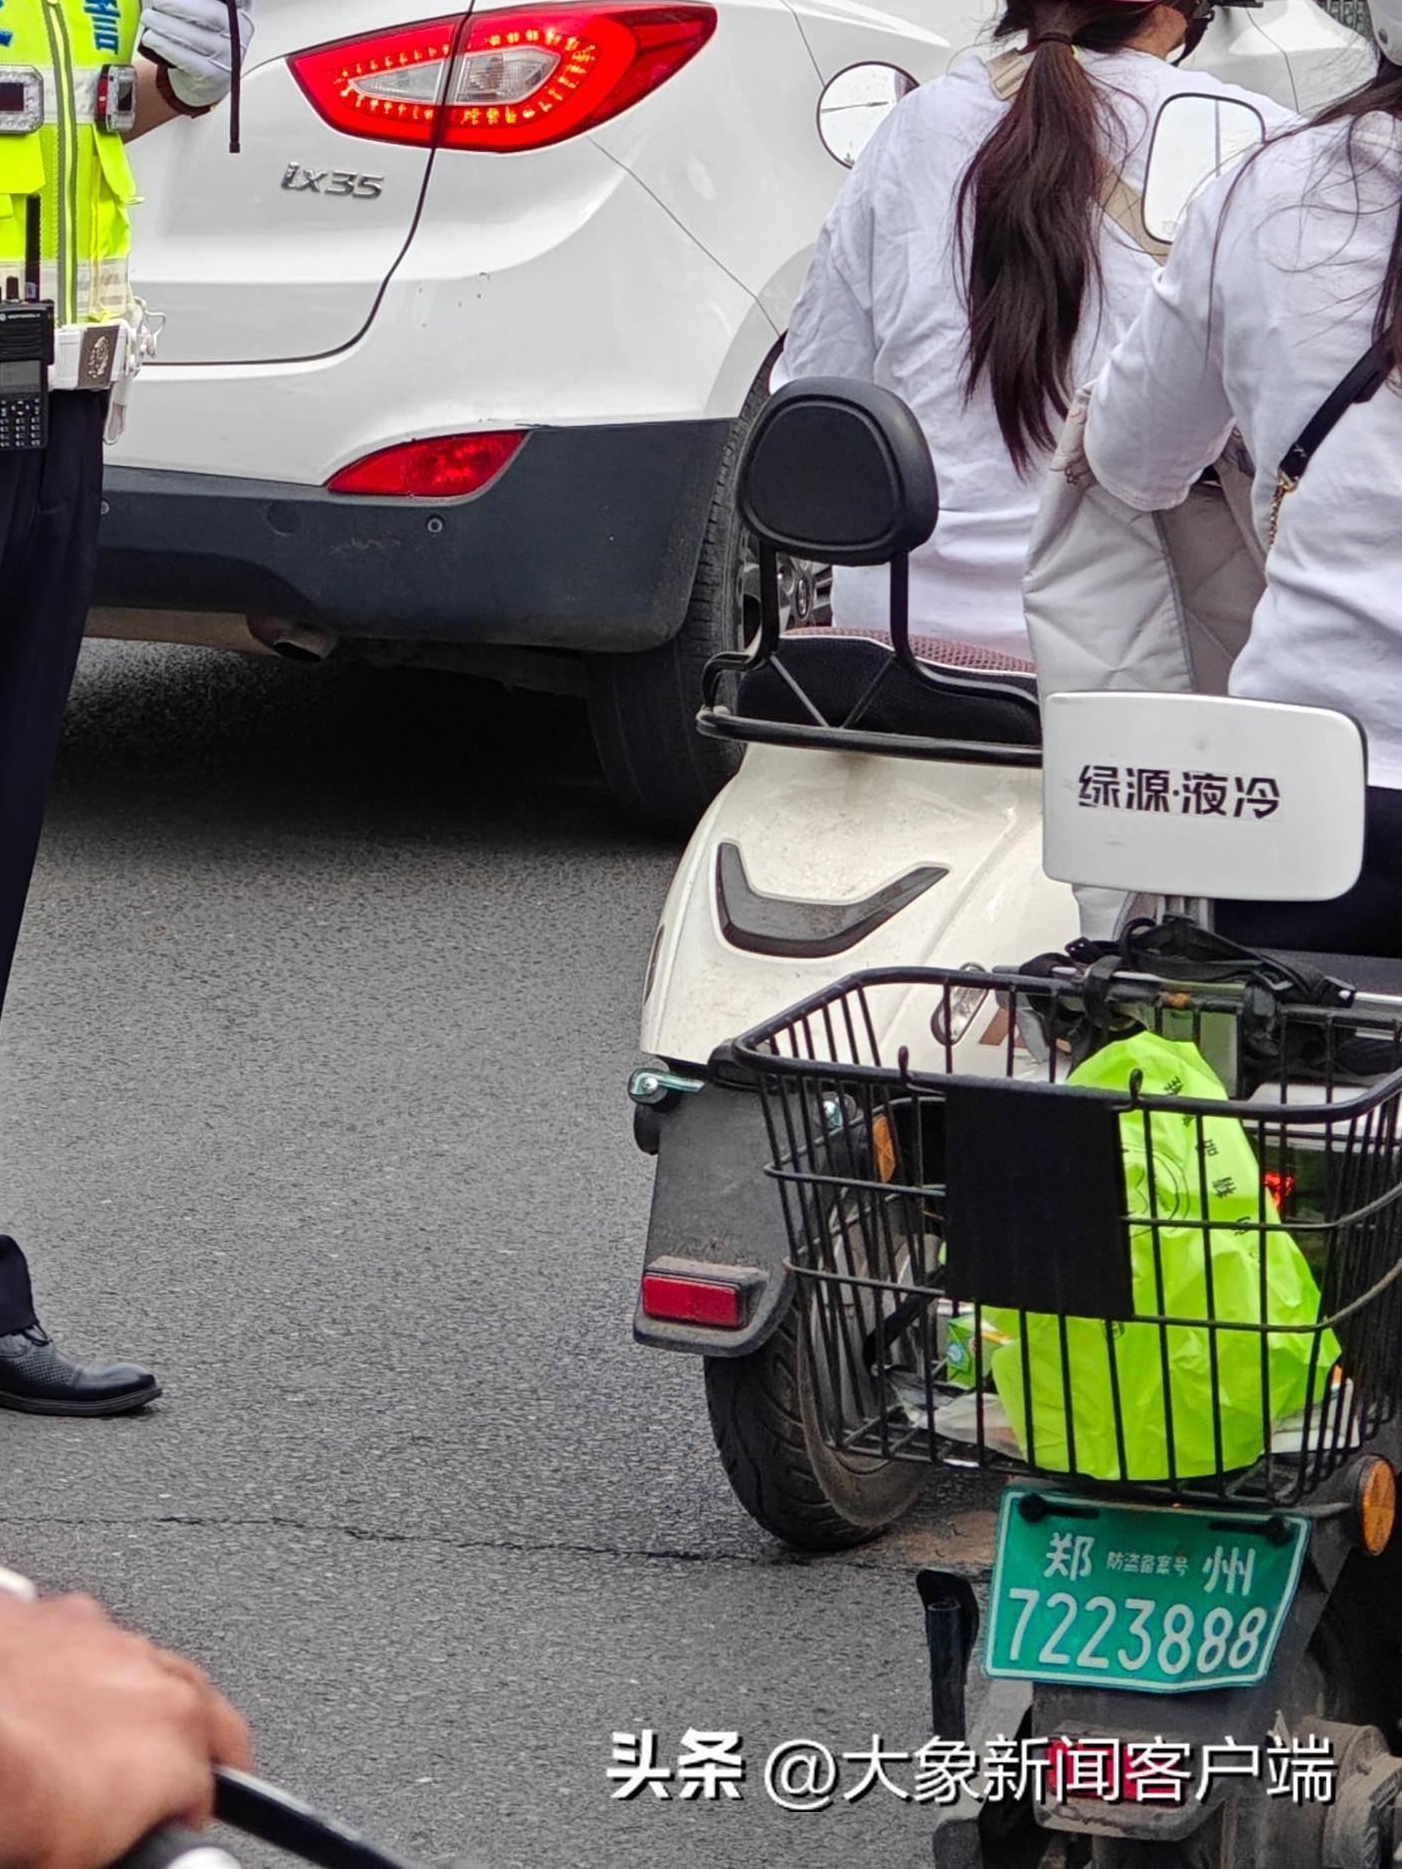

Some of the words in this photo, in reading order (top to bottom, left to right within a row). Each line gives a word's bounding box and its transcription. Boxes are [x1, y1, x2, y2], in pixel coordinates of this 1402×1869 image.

[281, 161, 385, 200] ix35
[1043, 1532, 1095, 1581] 郑
[1106, 1551, 1190, 1577] 防盗备案号
[1202, 1545, 1256, 1596] 州
[1008, 1587, 1268, 1676] 7223888
